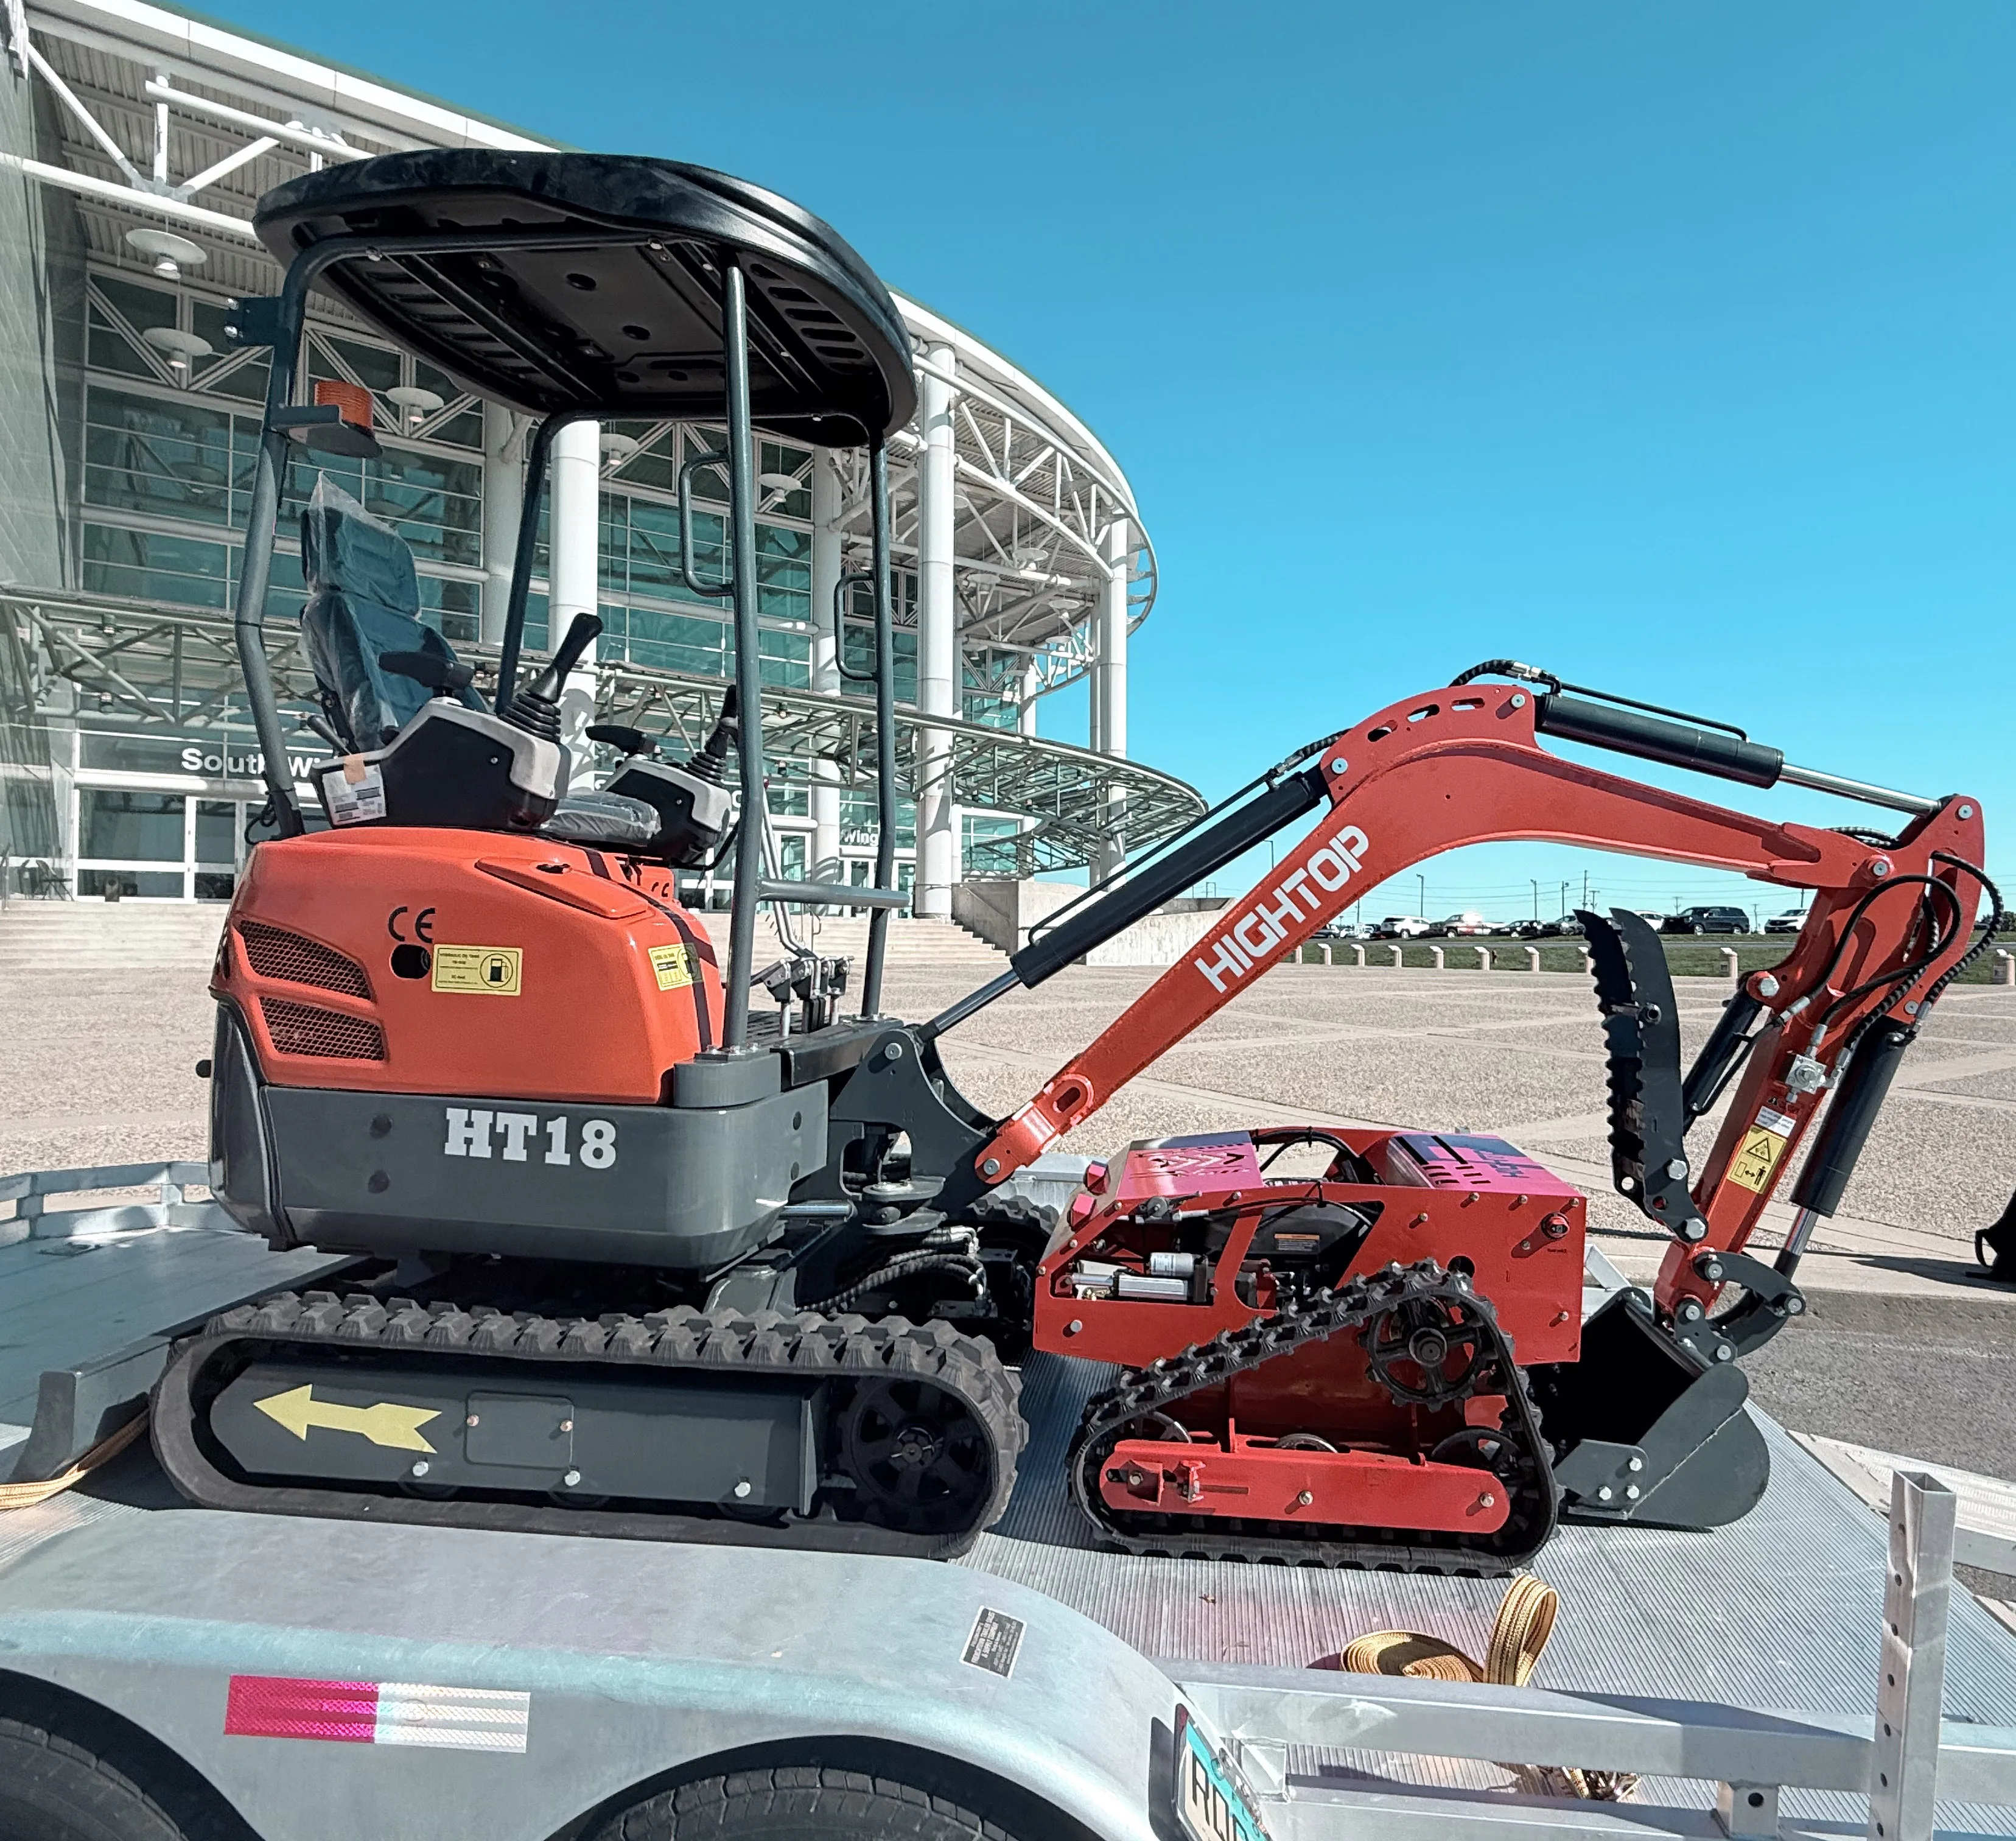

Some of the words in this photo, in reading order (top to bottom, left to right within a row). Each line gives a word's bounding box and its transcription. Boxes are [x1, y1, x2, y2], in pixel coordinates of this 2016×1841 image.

[388, 906, 436, 943] CE
[1194, 825, 1369, 994] HIGHTOP
[444, 1107, 617, 1169] HT18
